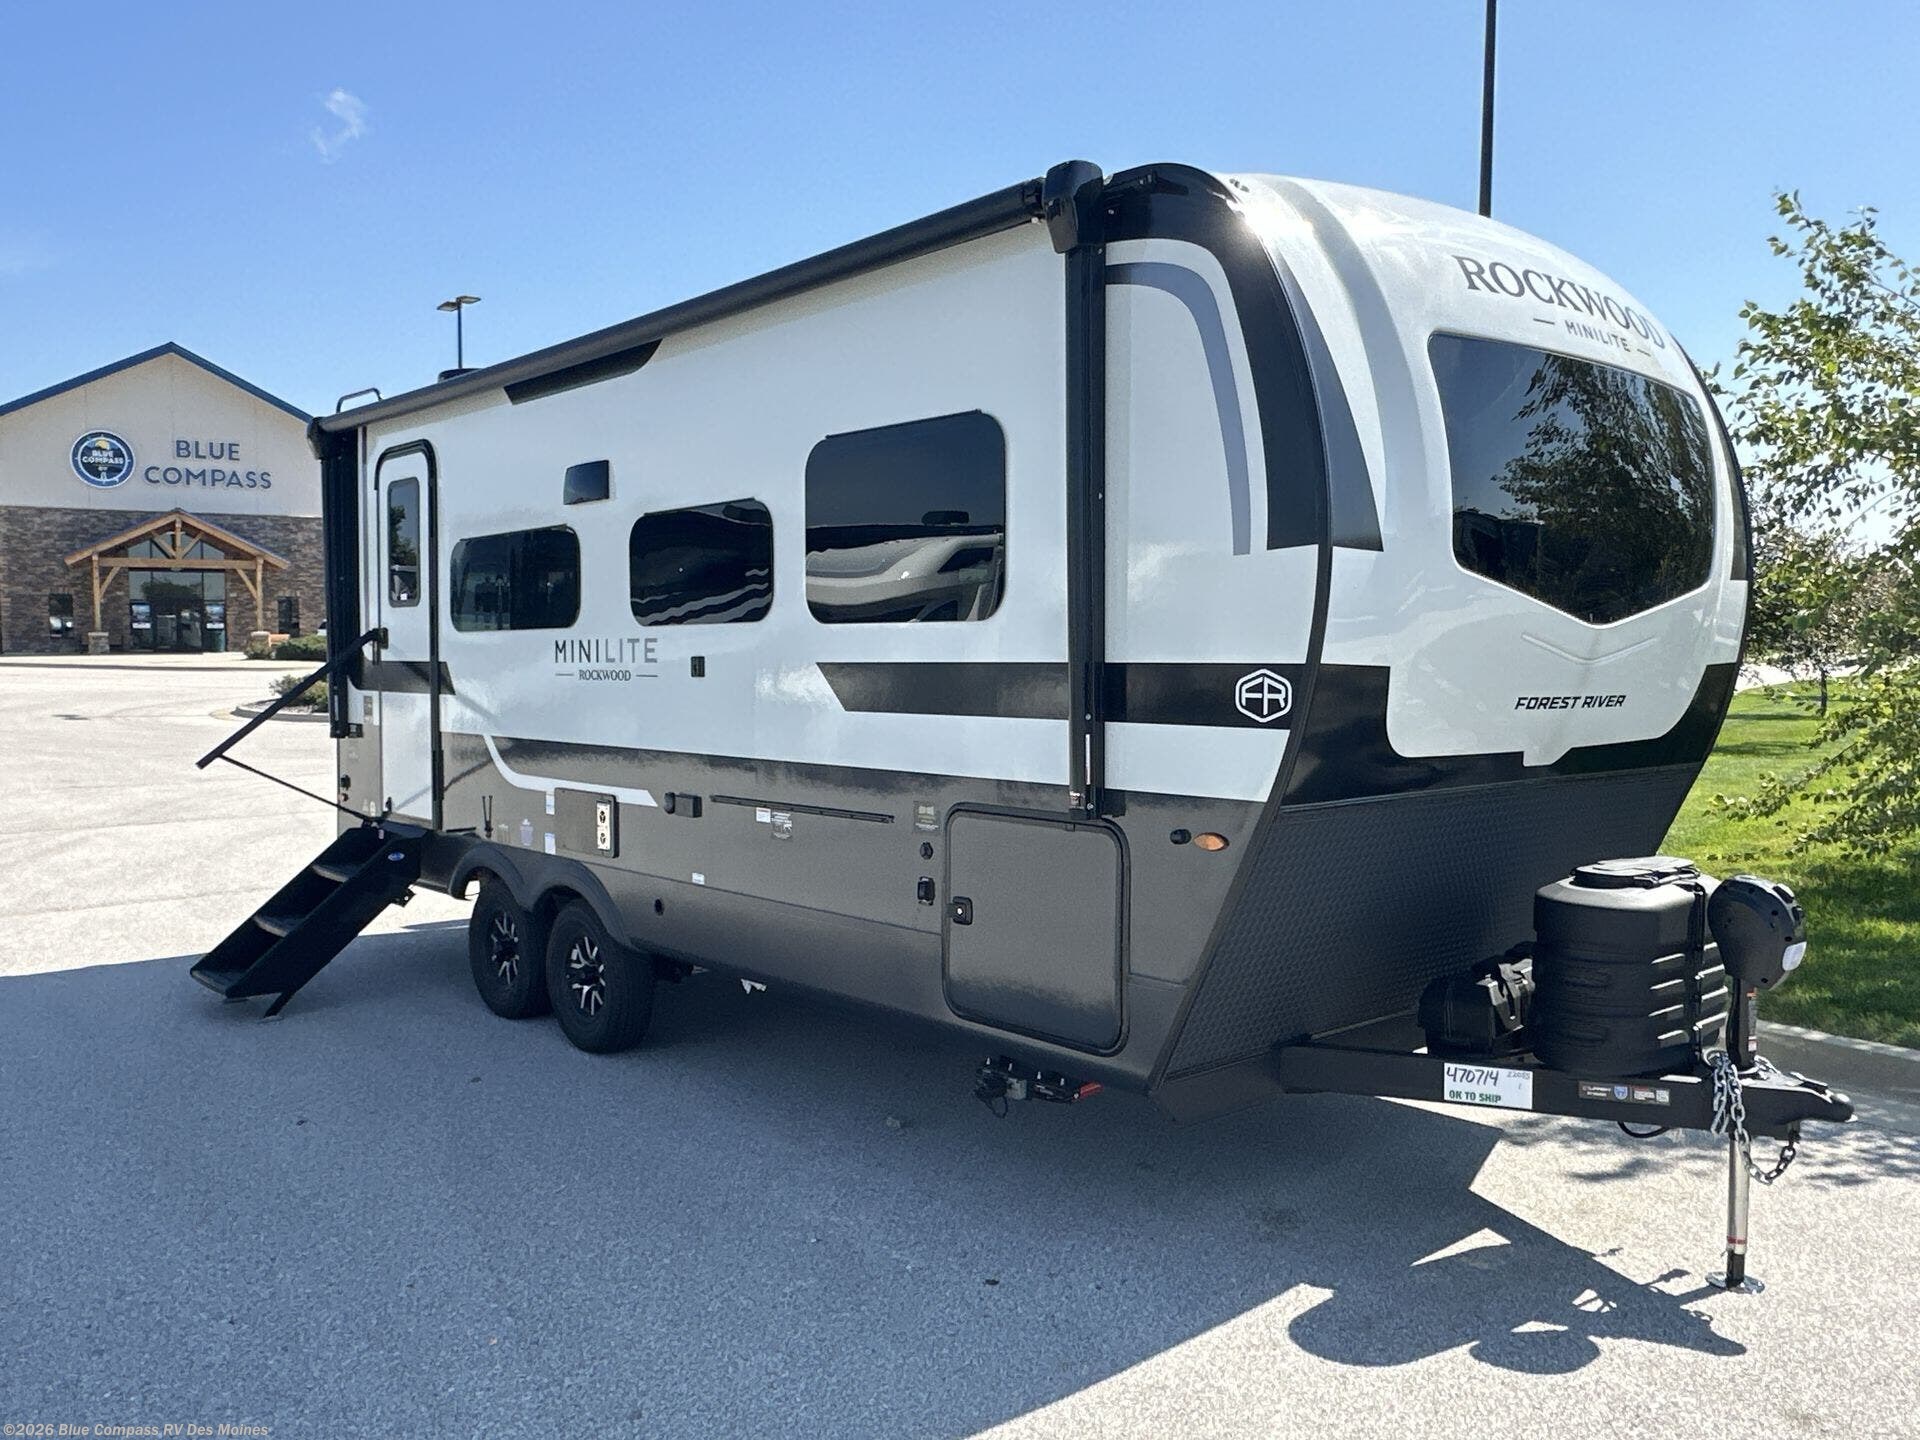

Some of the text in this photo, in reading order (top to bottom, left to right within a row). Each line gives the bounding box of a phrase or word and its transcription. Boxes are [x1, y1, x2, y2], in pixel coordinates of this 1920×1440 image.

[1452, 255, 1665, 349] ROCKWOOD
[1564, 319, 1631, 353] MINILITE
[82, 456, 123, 464] COMPASS
[176, 440, 240, 460] BLUE
[144, 466, 271, 489] COMPASS
[555, 638, 658, 663] MINILITE
[579, 669, 632, 681] ROCKWOOD
[1514, 695, 1626, 710] FOREST RIVER
[1446, 1066, 1499, 1086] 470714
[1449, 1090, 1502, 1104] OK TO SHIP
